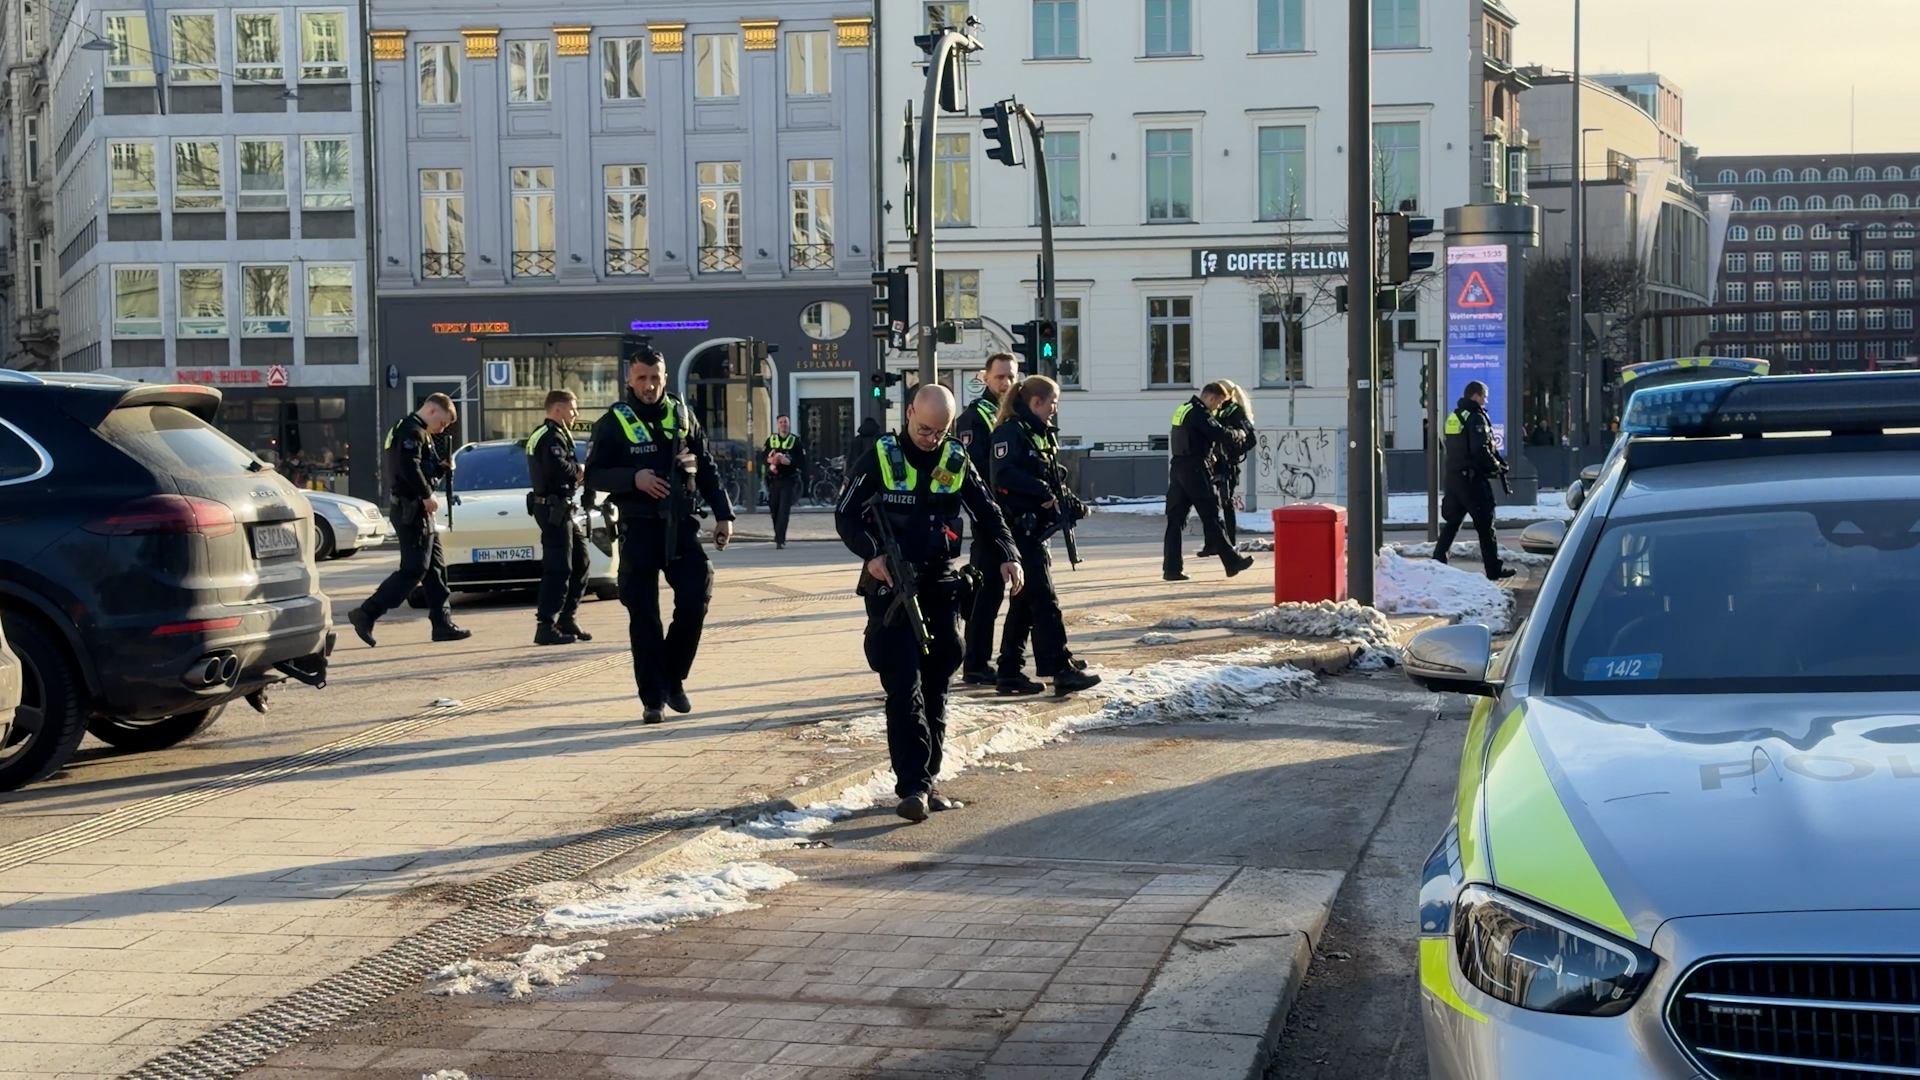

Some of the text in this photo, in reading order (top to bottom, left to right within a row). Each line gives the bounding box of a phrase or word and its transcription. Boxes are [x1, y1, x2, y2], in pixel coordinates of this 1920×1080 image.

[1483, 250, 1502, 258] 15:35
[1227, 253, 1286, 271] COFFEE
[1450, 312, 1503, 321] Wetterwarnung
[469, 321, 510, 333] BAKER
[825, 342, 839, 351] 29
[825, 351, 838, 360] 30
[1474, 353, 1499, 361] Warnung
[796, 360, 853, 369] ESPLANADE
[176, 369, 261, 383] NUR HIER
[490, 363, 508, 384] U
[630, 444, 658, 454] POLIZEI
[882, 493, 916, 505] POLIZEI
[478, 548, 532, 560] HH NM 942E
[1606, 659, 1642, 678] 14/2
